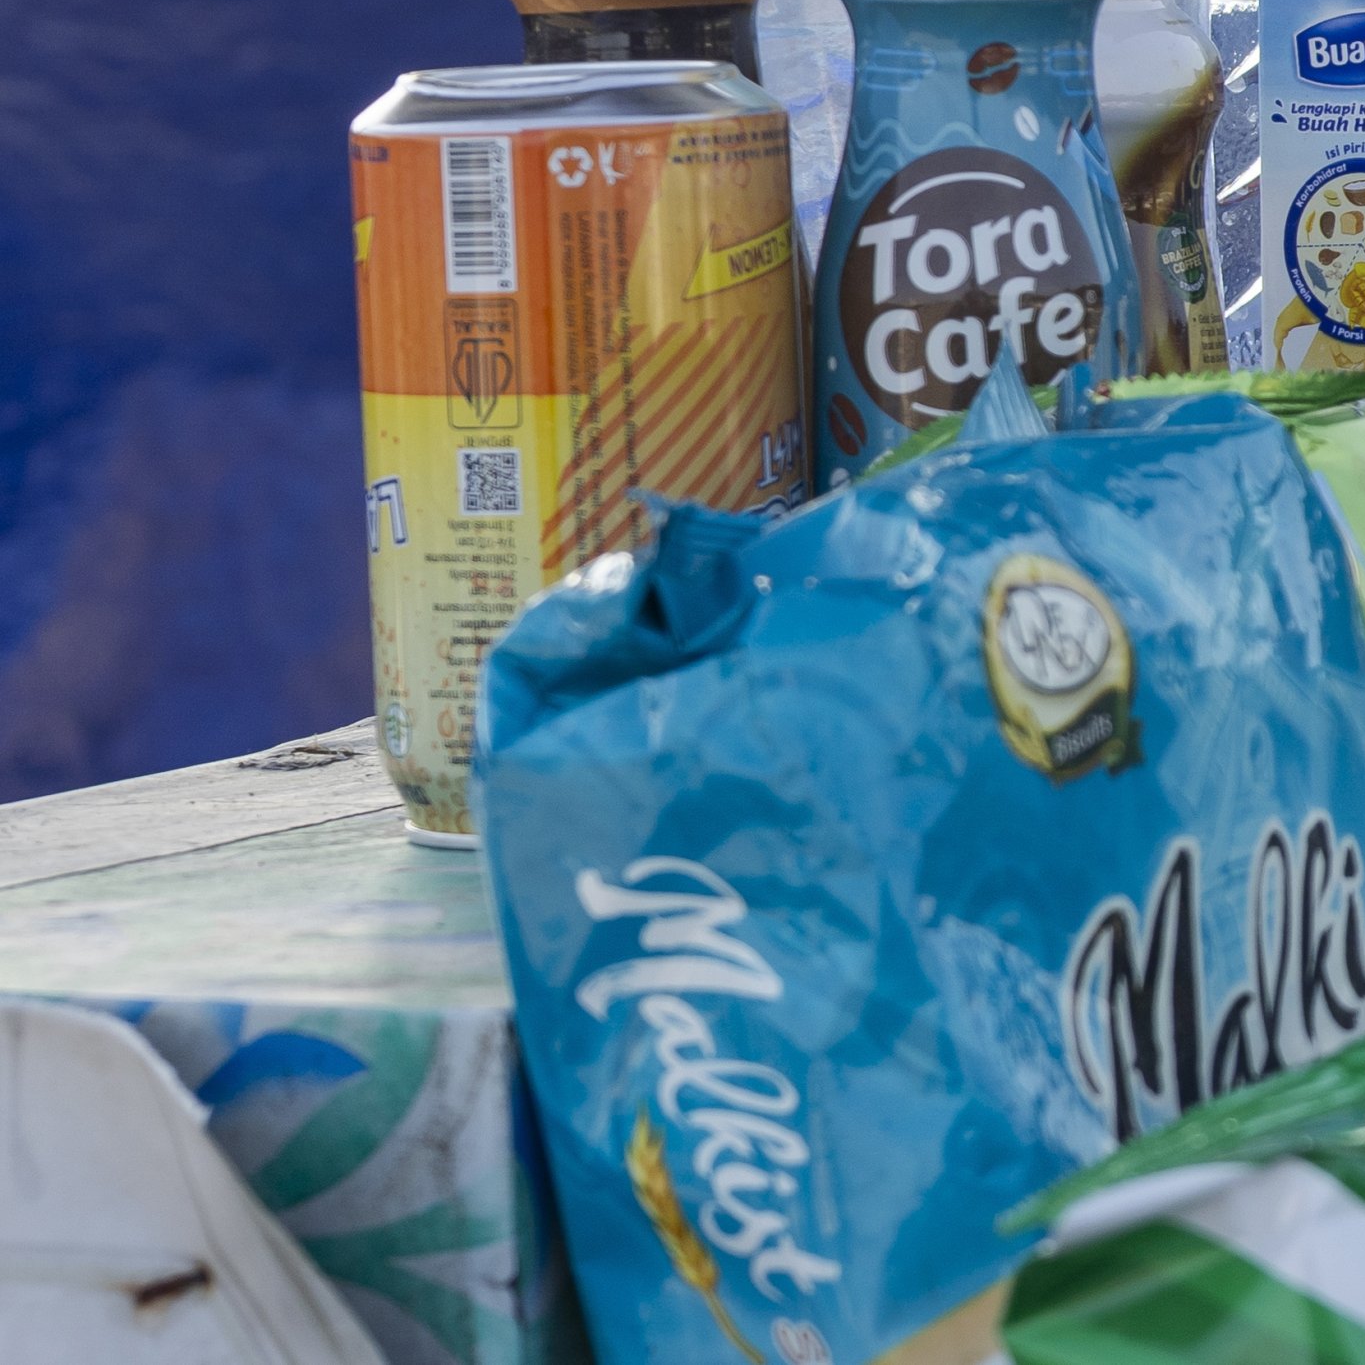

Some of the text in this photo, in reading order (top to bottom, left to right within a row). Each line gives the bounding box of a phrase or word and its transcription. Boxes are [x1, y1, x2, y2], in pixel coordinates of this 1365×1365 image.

[1291, 103, 1356, 117] Lengkapi
[1297, 116, 1349, 133] Buah
[1325, 144, 1341, 160] Isi
[1295, 163, 1348, 209] Karbohidrat
[857, 203, 1071, 306] Tora
[1291, 268, 1313, 304] Protein
[864, 276, 1087, 396] Cafe
[1337, 326, 1364, 341] Porsi
[576, 853, 842, 1303] Malkist
